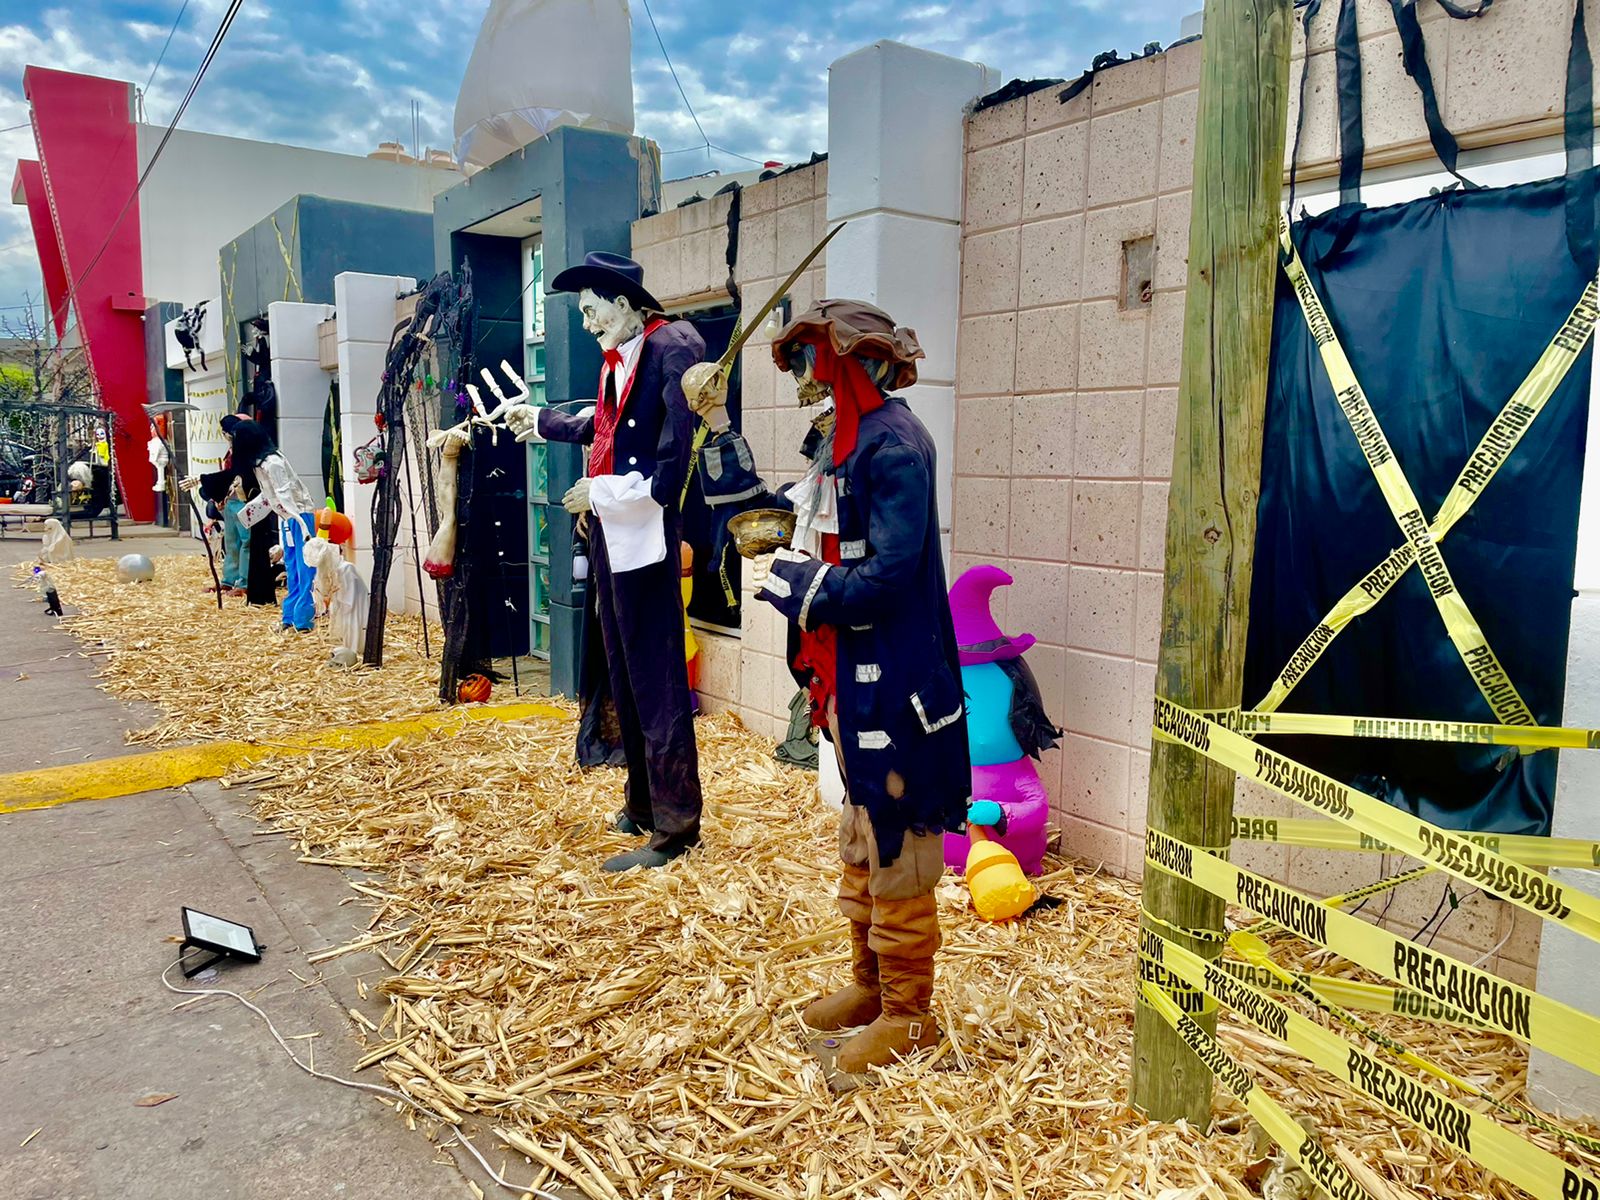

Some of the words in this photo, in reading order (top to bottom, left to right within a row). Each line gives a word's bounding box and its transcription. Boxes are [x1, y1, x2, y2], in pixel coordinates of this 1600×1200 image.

[1281, 623, 1335, 689] PRECAUCION
[1458, 401, 1536, 495] PRECAUCION
[1338, 384, 1393, 468] PRECAUCION
[1399, 509, 1454, 599] PRECAUCION
[1464, 644, 1534, 727] PRECAUCIO
[1203, 964, 1289, 1042] PRECAUCION
[1346, 1047, 1471, 1154] PRECAUCION
[1236, 871, 1328, 946] PRECAUCION
[1393, 940, 1531, 1040] PRECAUCION
